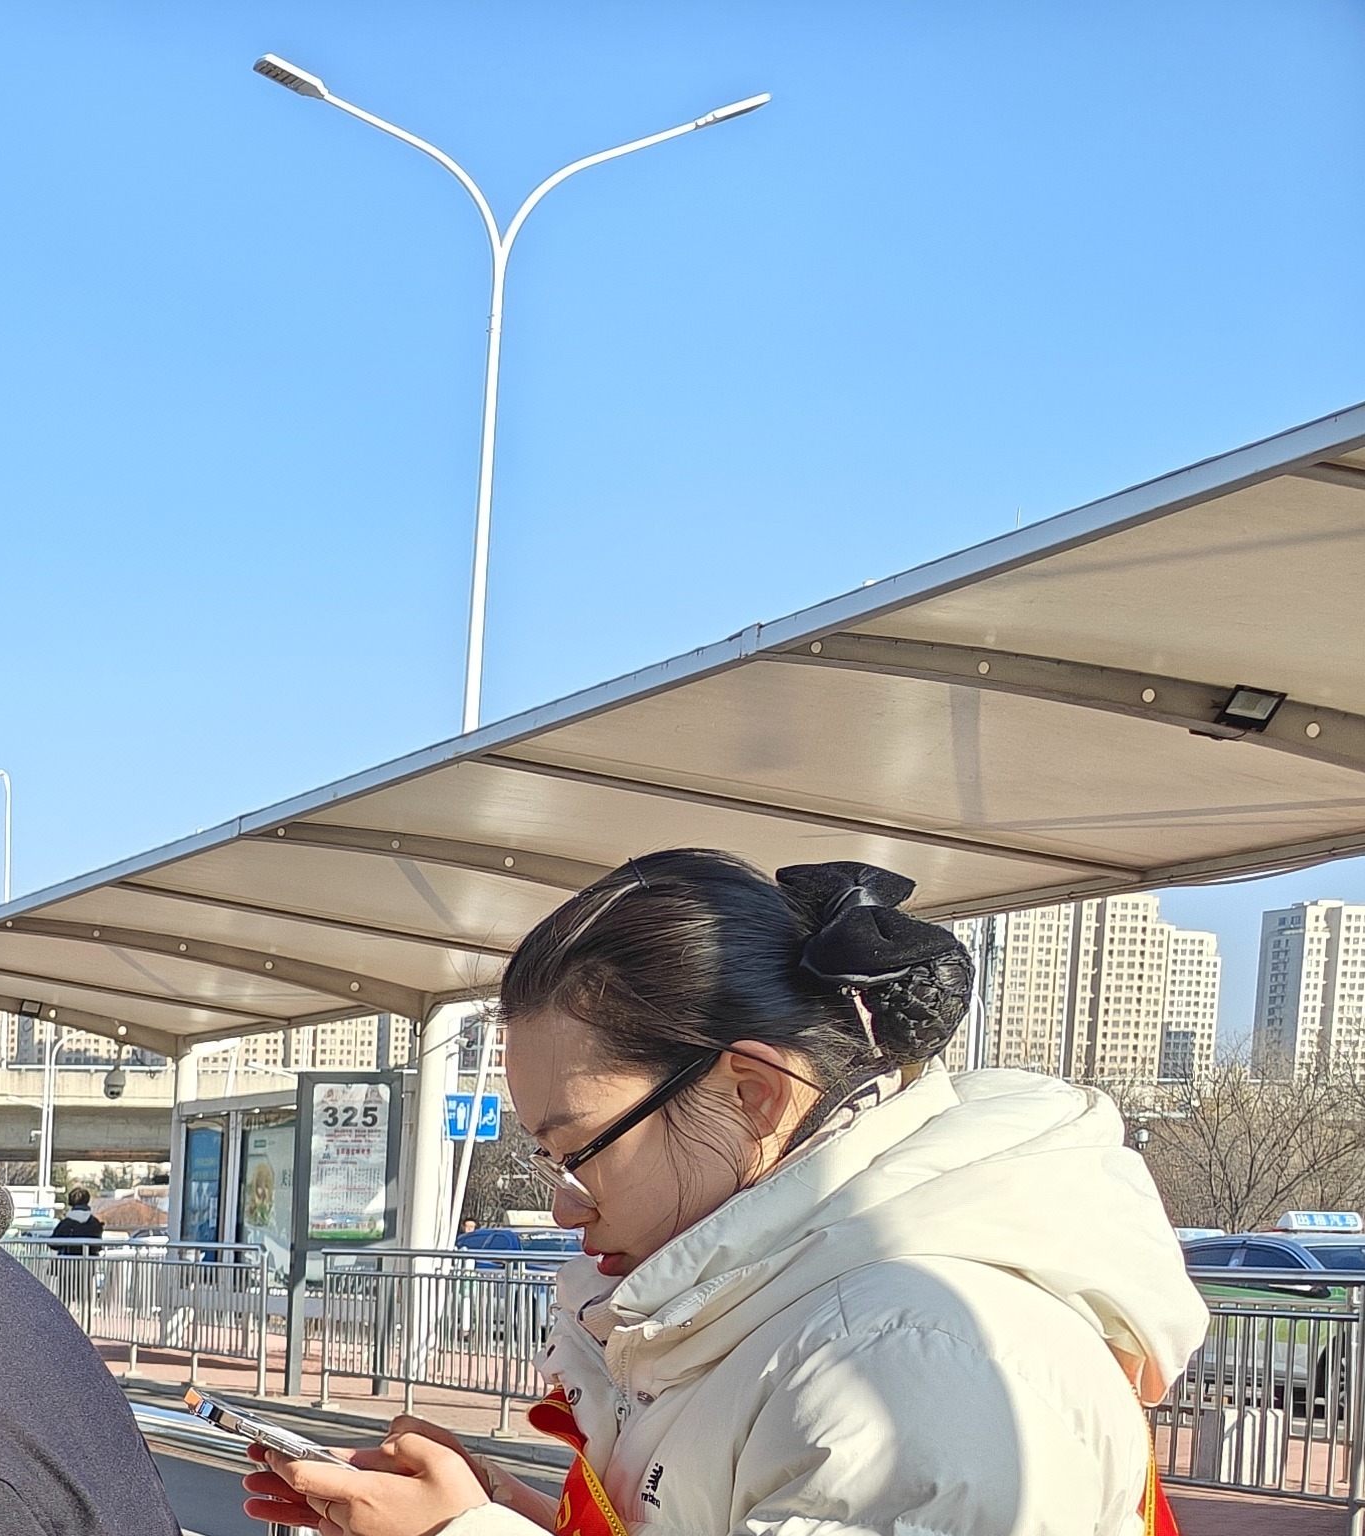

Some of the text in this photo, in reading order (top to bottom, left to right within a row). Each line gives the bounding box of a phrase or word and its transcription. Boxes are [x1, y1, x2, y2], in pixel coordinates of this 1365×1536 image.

[322, 1106, 379, 1127] 325
[1297, 1213, 1358, 1227] 出租汽车
